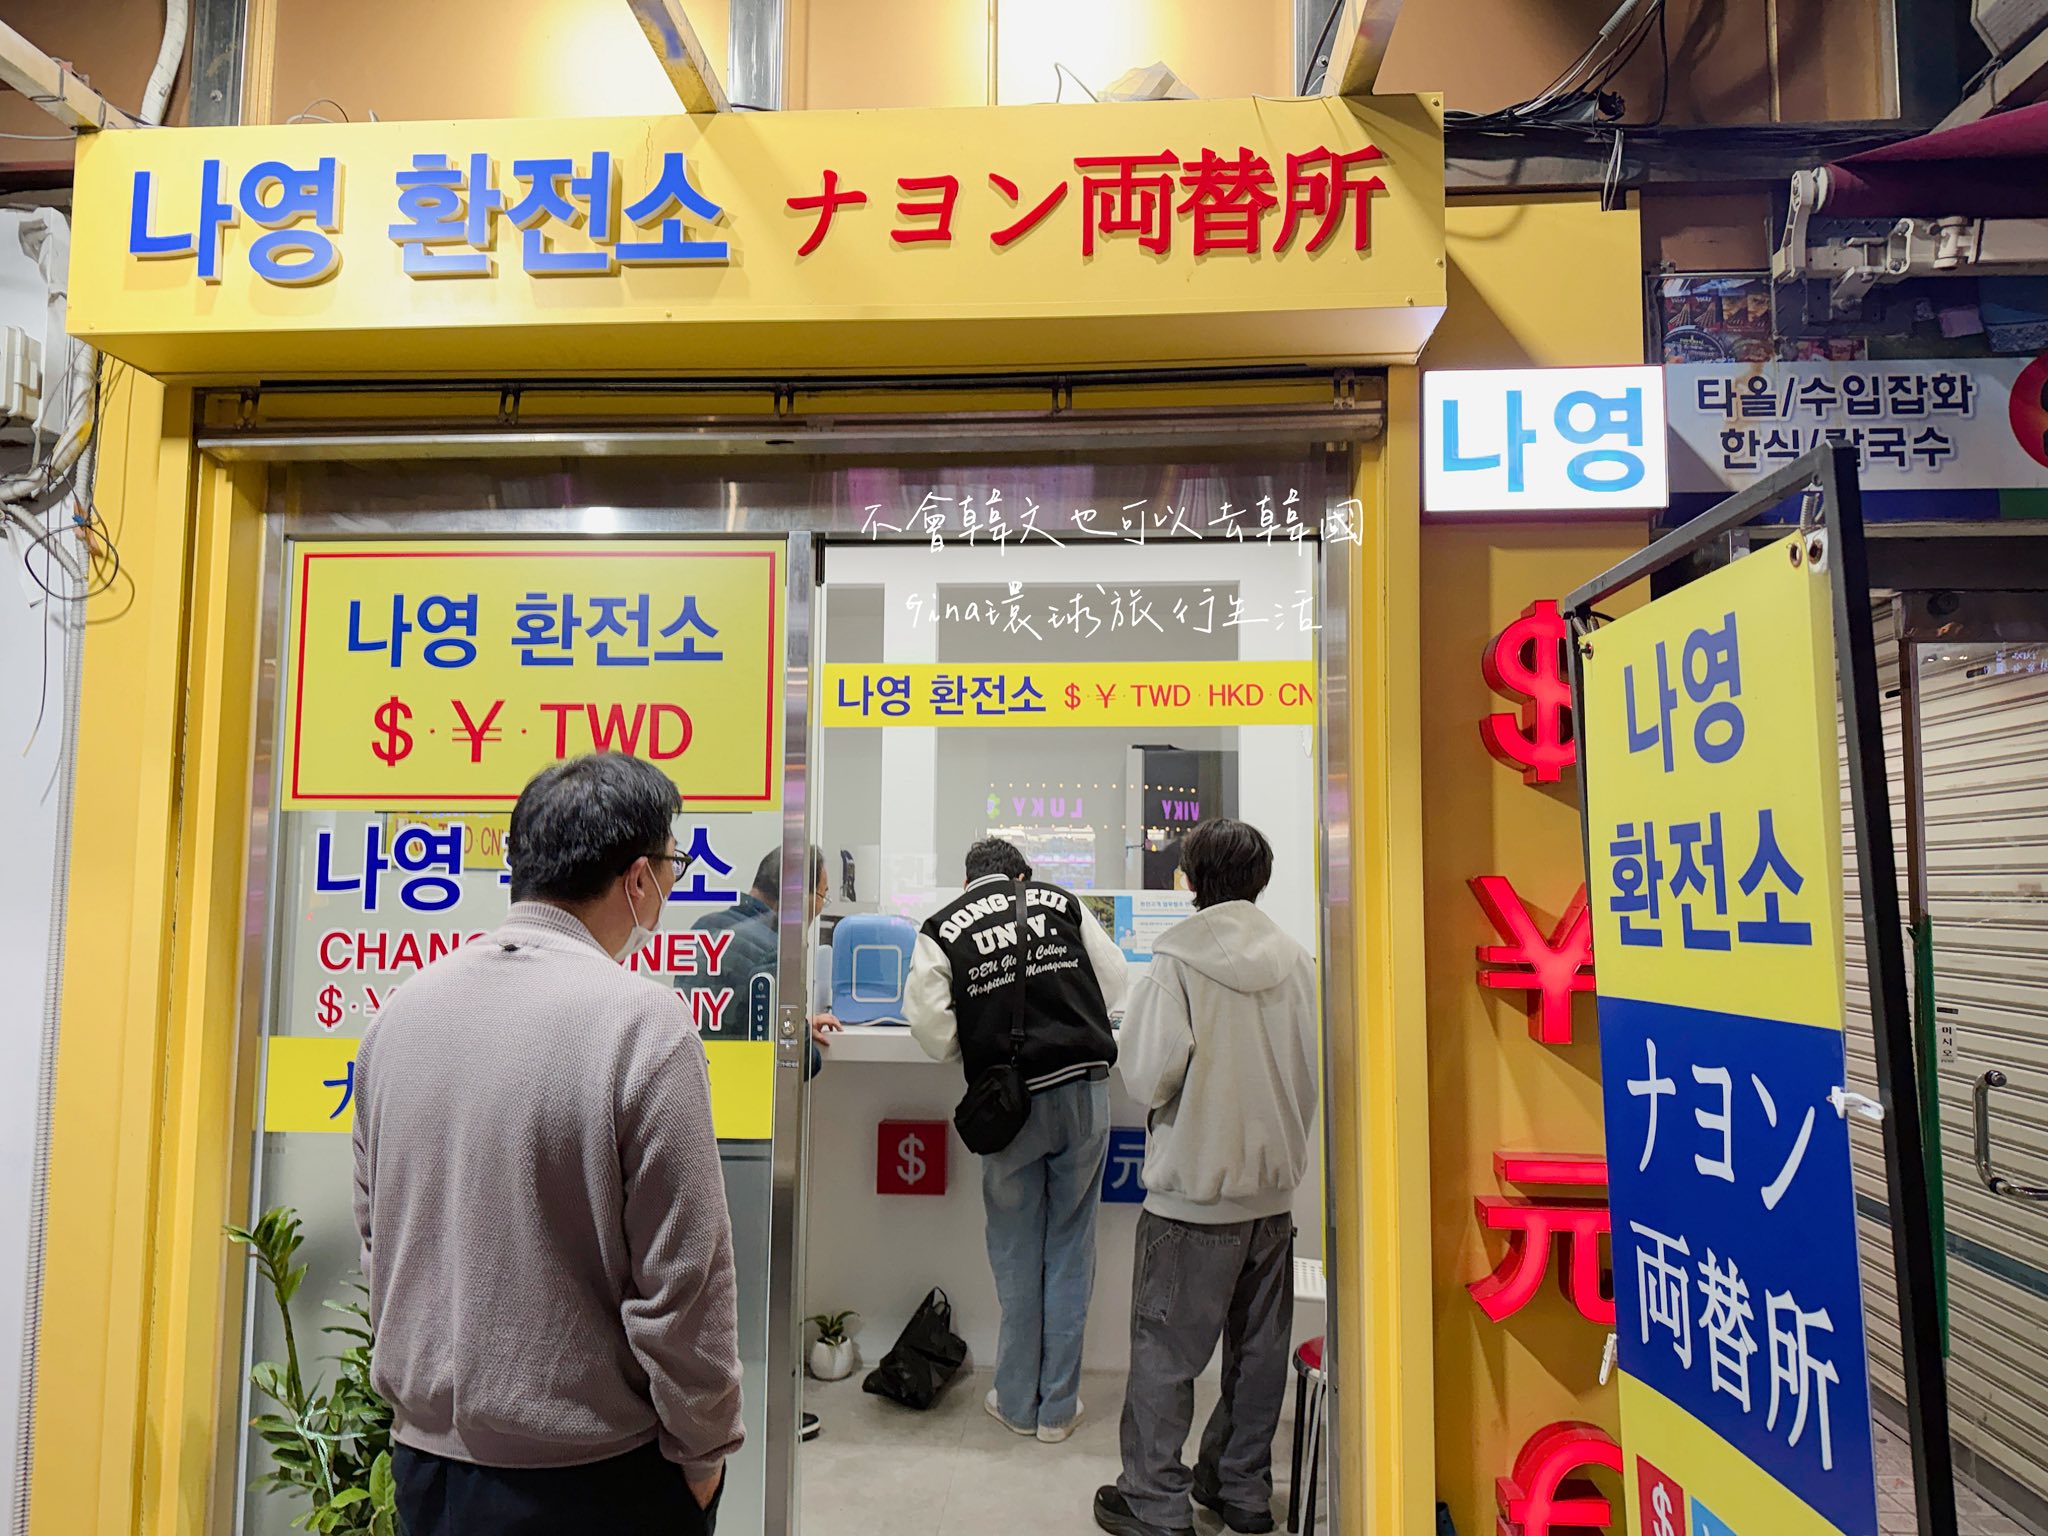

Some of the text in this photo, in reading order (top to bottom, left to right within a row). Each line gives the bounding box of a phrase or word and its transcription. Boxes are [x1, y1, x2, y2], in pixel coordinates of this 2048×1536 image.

[130, 145, 1387, 285] 나영 환전소 ナヨン両替所
[1697, 373, 1973, 418] 타올/수입잡화
[1442, 387, 1646, 493] 나영
[348, 592, 724, 669] 나영 환전소
[838, 675, 911, 716] 나영
[929, 675, 1046, 716] 환전소
[1130, 684, 1191, 707] TWD
[1209, 683, 1264, 707] HKD
[1278, 682, 1313, 706] CN
[1623, 611, 1745, 773] 나영
[371, 696, 693, 767] $ ¥ TWD
[316, 826, 463, 911] 나영
[1610, 808, 1813, 952] 환전소
[320, 931, 732, 972] CHAN NEY
[939, 888, 1068, 944] DONG-EUI
[972, 913, 1058, 955] UNV.
[967, 958, 1079, 998] Hospitalit Management
[1035, 944, 1067, 961] College
[896, 1133, 926, 1185] $
[1627, 1037, 1816, 1211] ナヨン
[1630, 1220, 1840, 1472] 両替所
